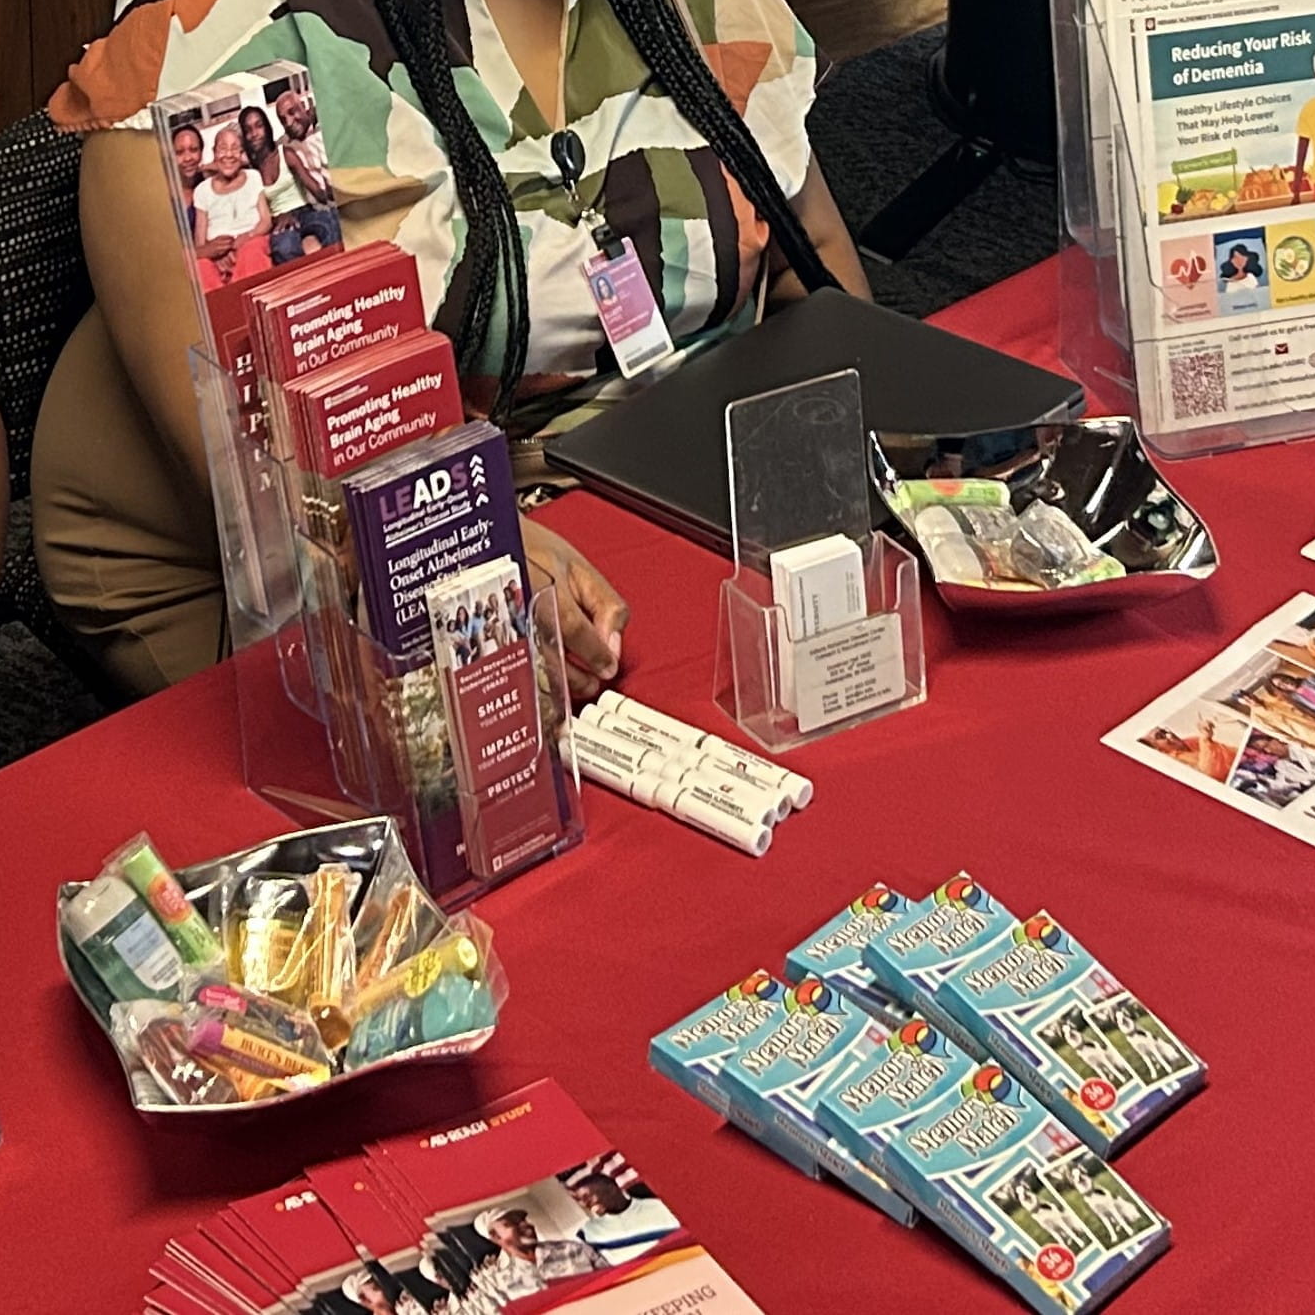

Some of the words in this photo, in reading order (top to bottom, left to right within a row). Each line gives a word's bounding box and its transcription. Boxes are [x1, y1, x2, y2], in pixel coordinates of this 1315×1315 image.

[1171, 39, 1243, 62] Reducing
[1243, 36, 1278, 52] Your
[1279, 28, 1312, 48] Risk
[1172, 67, 1189, 86] of
[1190, 58, 1264, 83] Dementia
[1175, 103, 1213, 117] Healthy
[1213, 97, 1254, 112] Lifestyle
[1254, 93, 1292, 106] Choices
[1175, 120, 1199, 131] That
[1199, 118, 1220, 128] May
[1220, 106, 1243, 125] Help
[1244, 110, 1275, 122] Lower
[1176, 135, 1199, 146] Your
[1200, 131, 1221, 142] Risk
[1233, 123, 1279, 138] Dementia
[289, 303, 354, 339] Promoting
[353, 285, 405, 313] Healthy
[292, 333, 325, 357] Brain
[326, 318, 363, 342] Aging
[296, 360, 308, 373] in
[307, 350, 328, 368] Our
[330, 323, 399, 358] Community
[326, 393, 391, 431] Promoting
[391, 372, 442, 402] Healthy
[329, 424, 363, 449] Brain
[363, 407, 401, 433] Aging
[333, 452, 345, 466] in
[345, 441, 366, 460] Our
[367, 411, 436, 449] Community
[378, 459, 469, 523] LEADS
[387, 529, 459, 574] Longitudinal
[460, 519, 493, 555] Early-
[389, 565, 425, 591] Onset
[426, 535, 491, 575] Alzheimer's
[477, 688, 518, 718] SHARE
[481, 725, 527, 758] IMPACT
[487, 758, 536, 797] PROTECT
[930, 909, 989, 956] Match
[1006, 948, 1069, 998] Match
[786, 1013, 844, 1069] Match
[884, 1054, 948, 1109] Match
[1084, 1081, 1104, 1099] 36
[490, 1101, 533, 1127] STUDY
[956, 1102, 1021, 1158] Match
[1040, 1249, 1063, 1270] 36
